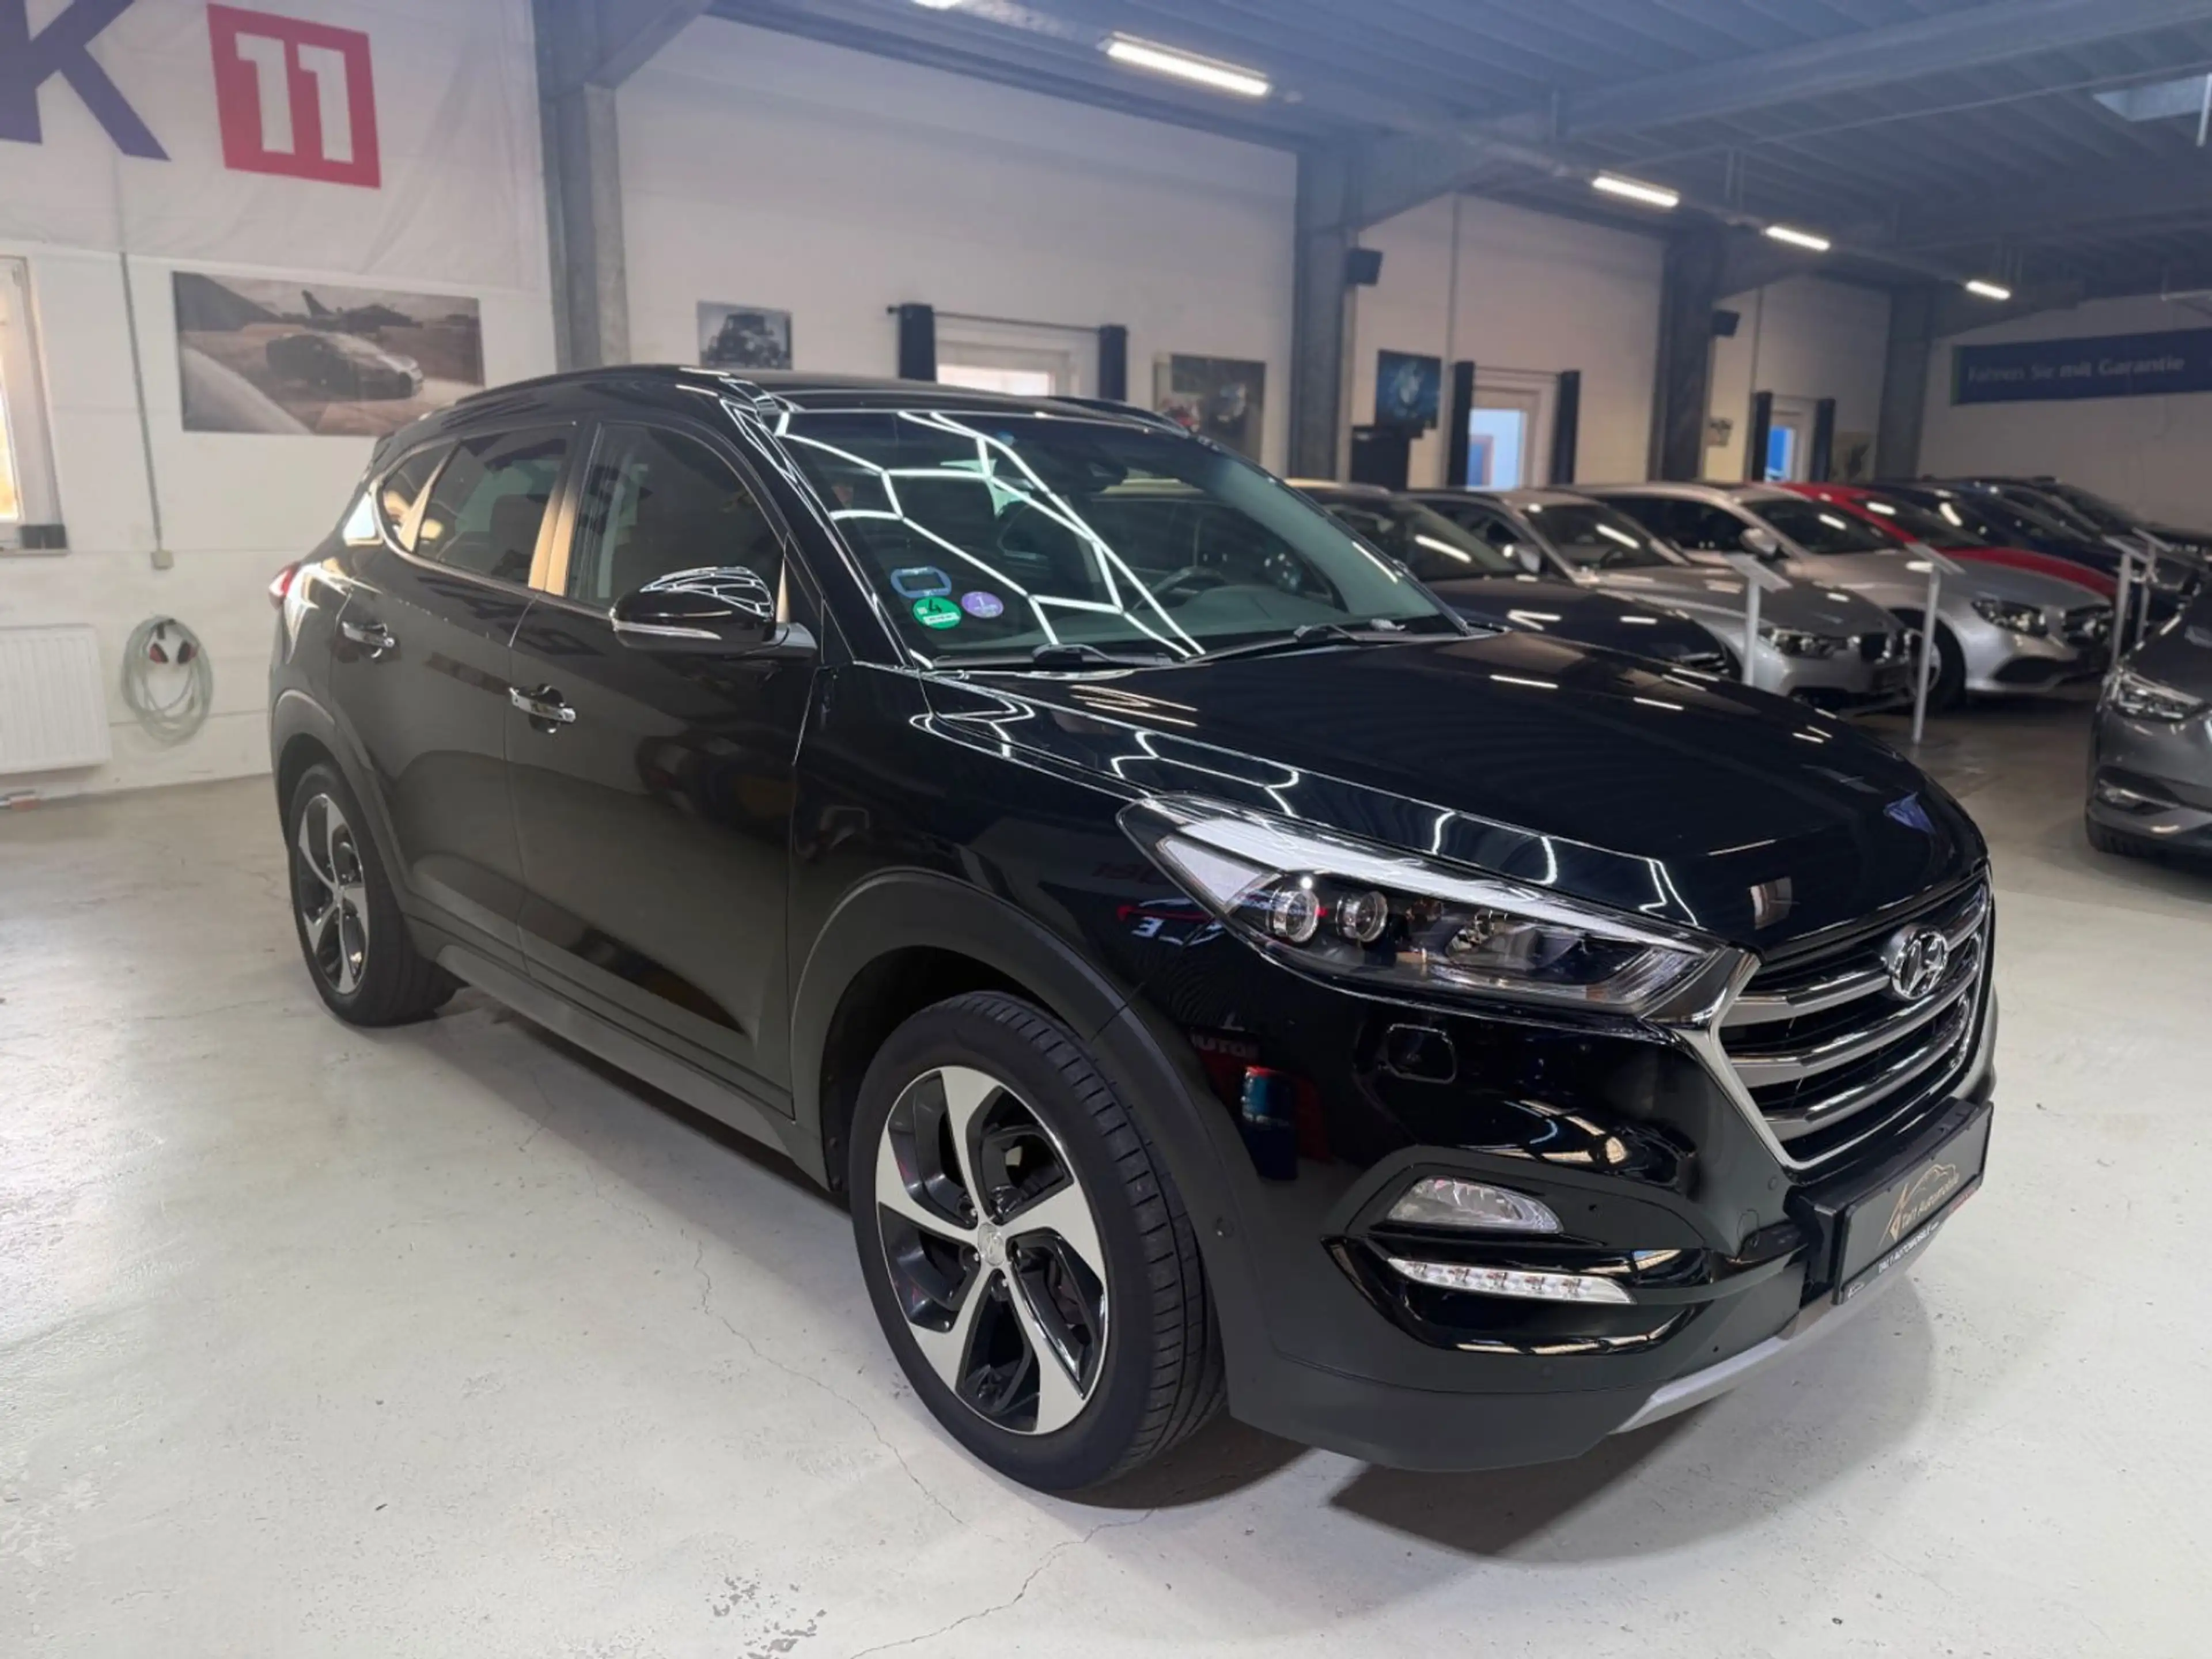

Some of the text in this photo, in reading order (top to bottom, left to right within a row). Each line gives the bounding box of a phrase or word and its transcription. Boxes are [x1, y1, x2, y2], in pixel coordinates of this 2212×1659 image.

[234, 32, 354, 164] 11
[2097, 354, 2186, 377] Garantie
[927, 599, 943, 613] 4
